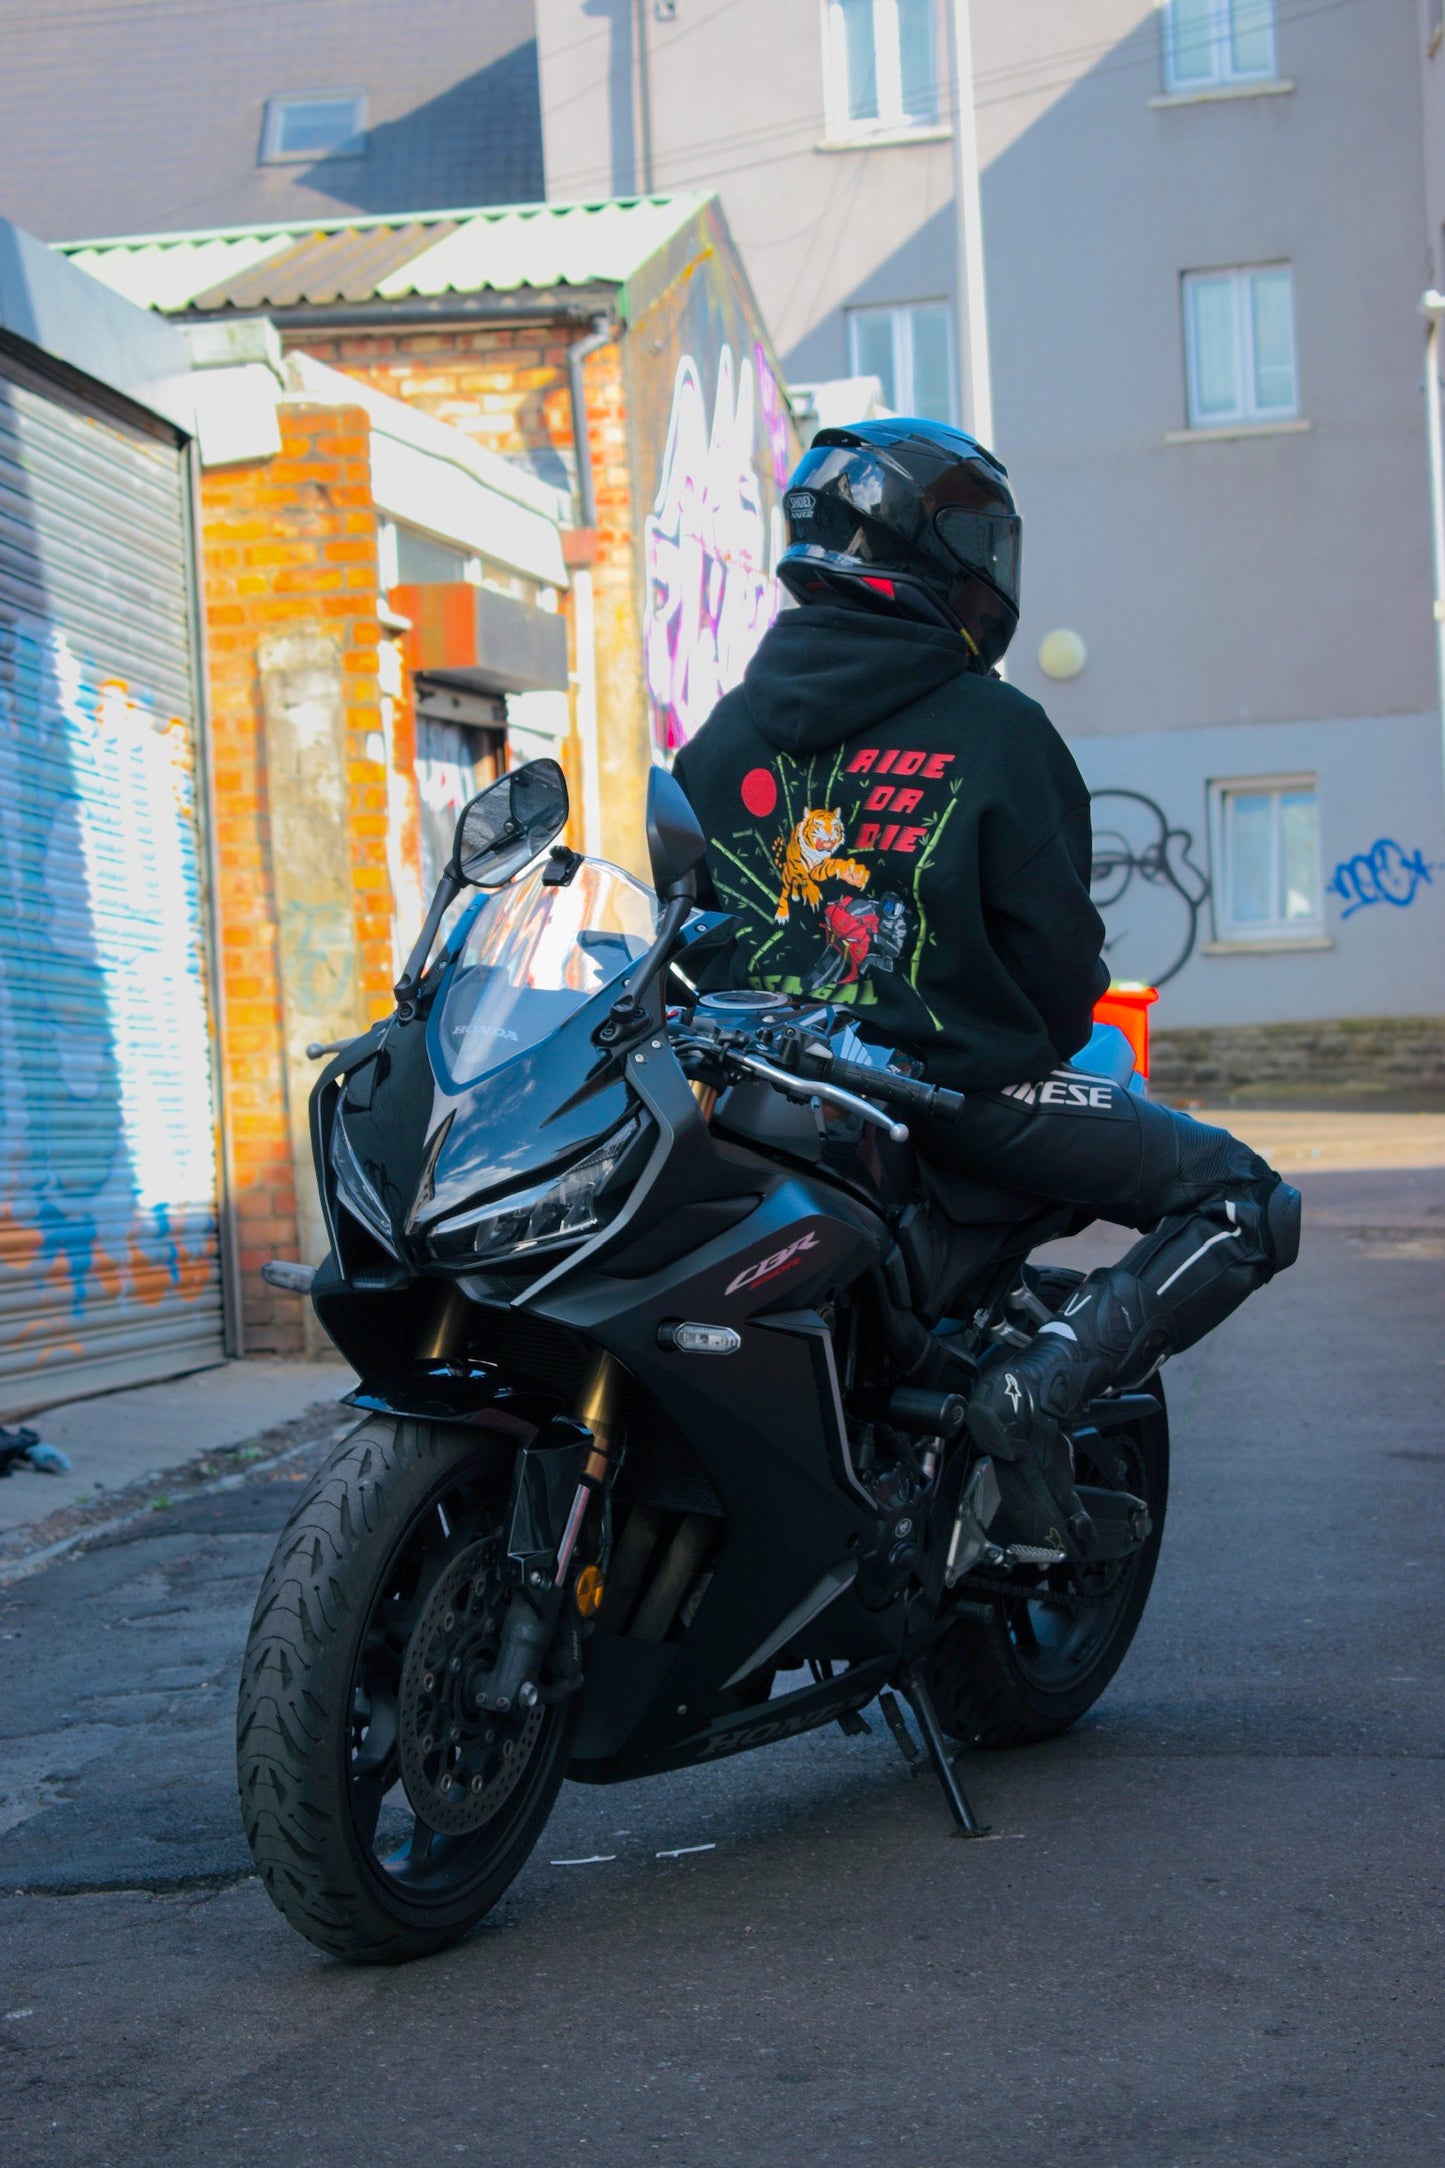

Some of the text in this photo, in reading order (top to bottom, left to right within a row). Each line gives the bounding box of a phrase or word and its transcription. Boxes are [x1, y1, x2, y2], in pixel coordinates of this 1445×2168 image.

[789, 495, 811, 509] SHOEI
[846, 749, 956, 779] RIDE
[864, 785, 925, 814] OR
[855, 823, 928, 852] DIE
[452, 1024, 519, 1042] HONDA
[724, 1230, 821, 1297] CBR
